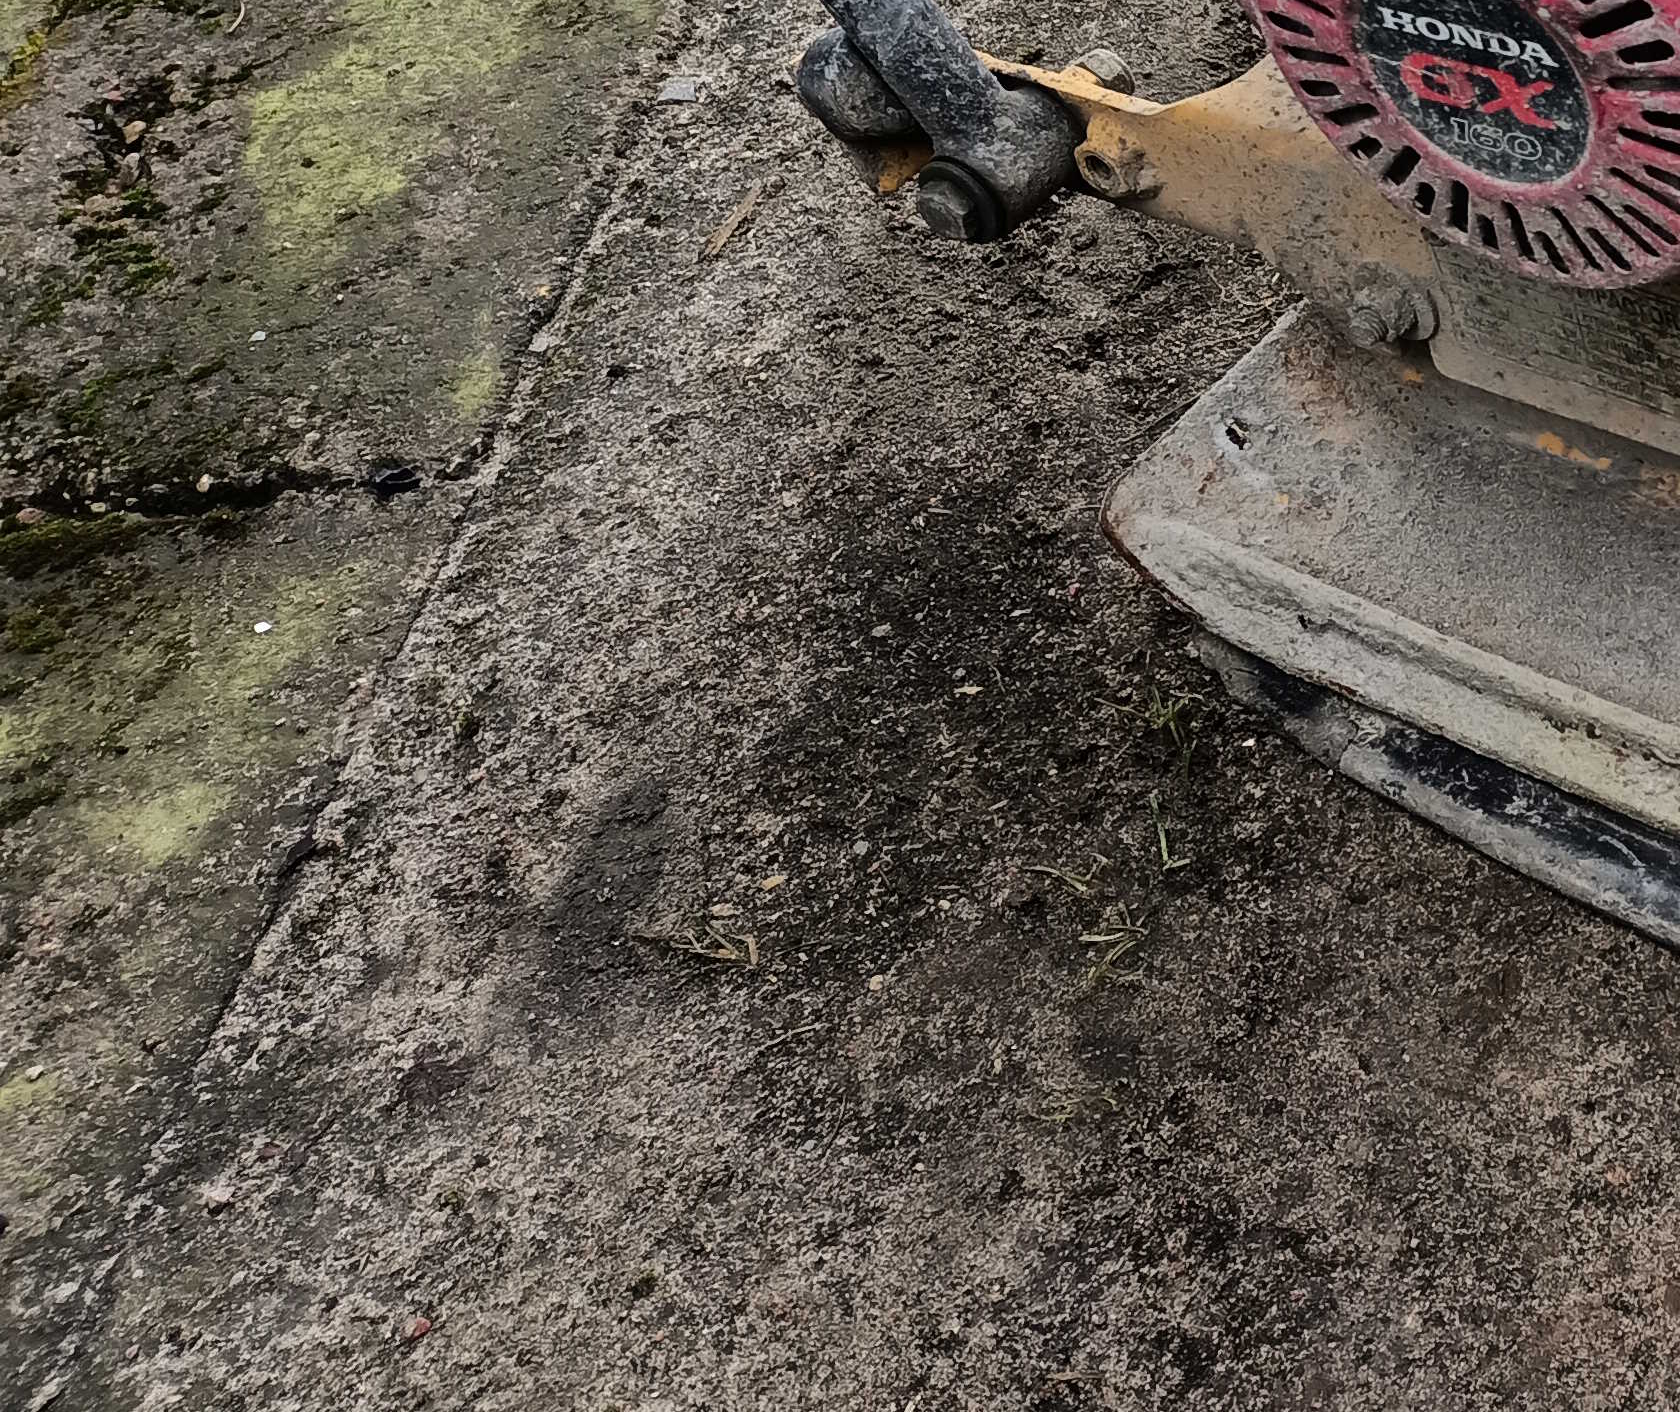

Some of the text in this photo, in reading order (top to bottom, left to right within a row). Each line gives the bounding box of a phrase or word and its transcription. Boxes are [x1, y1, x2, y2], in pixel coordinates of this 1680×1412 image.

[1377, 6, 1559, 67] HONDA
[1402, 52, 1557, 130] GX
[1450, 117, 1542, 160] 160
